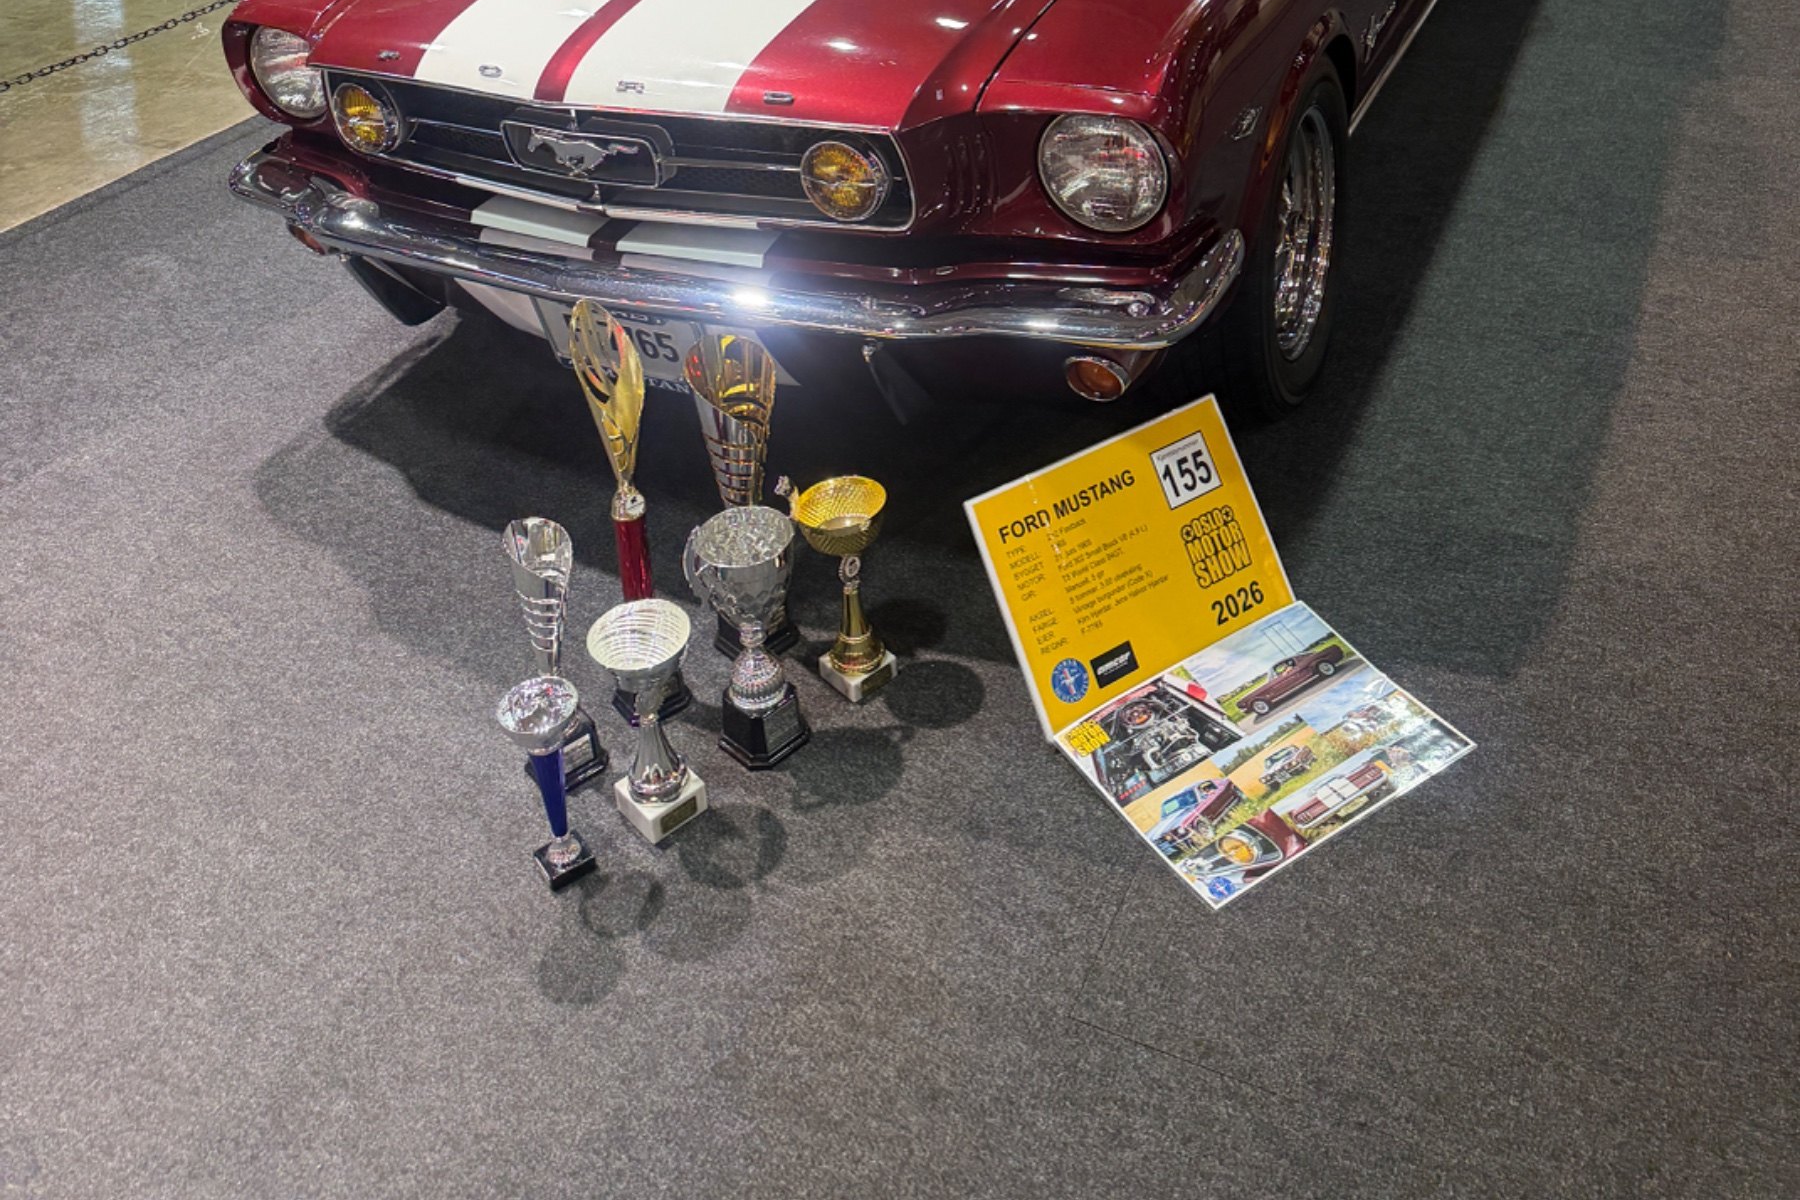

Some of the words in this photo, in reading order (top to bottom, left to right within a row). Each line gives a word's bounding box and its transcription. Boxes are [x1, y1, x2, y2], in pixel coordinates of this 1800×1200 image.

[1162, 449, 1212, 497] 155
[998, 508, 1052, 543] FORD
[1052, 469, 1135, 518] MUSTANG
[1192, 508, 1223, 538] OSLO
[1185, 520, 1244, 564] MOTOR
[1193, 541, 1252, 588] SHOW
[1211, 581, 1264, 625] 2026
